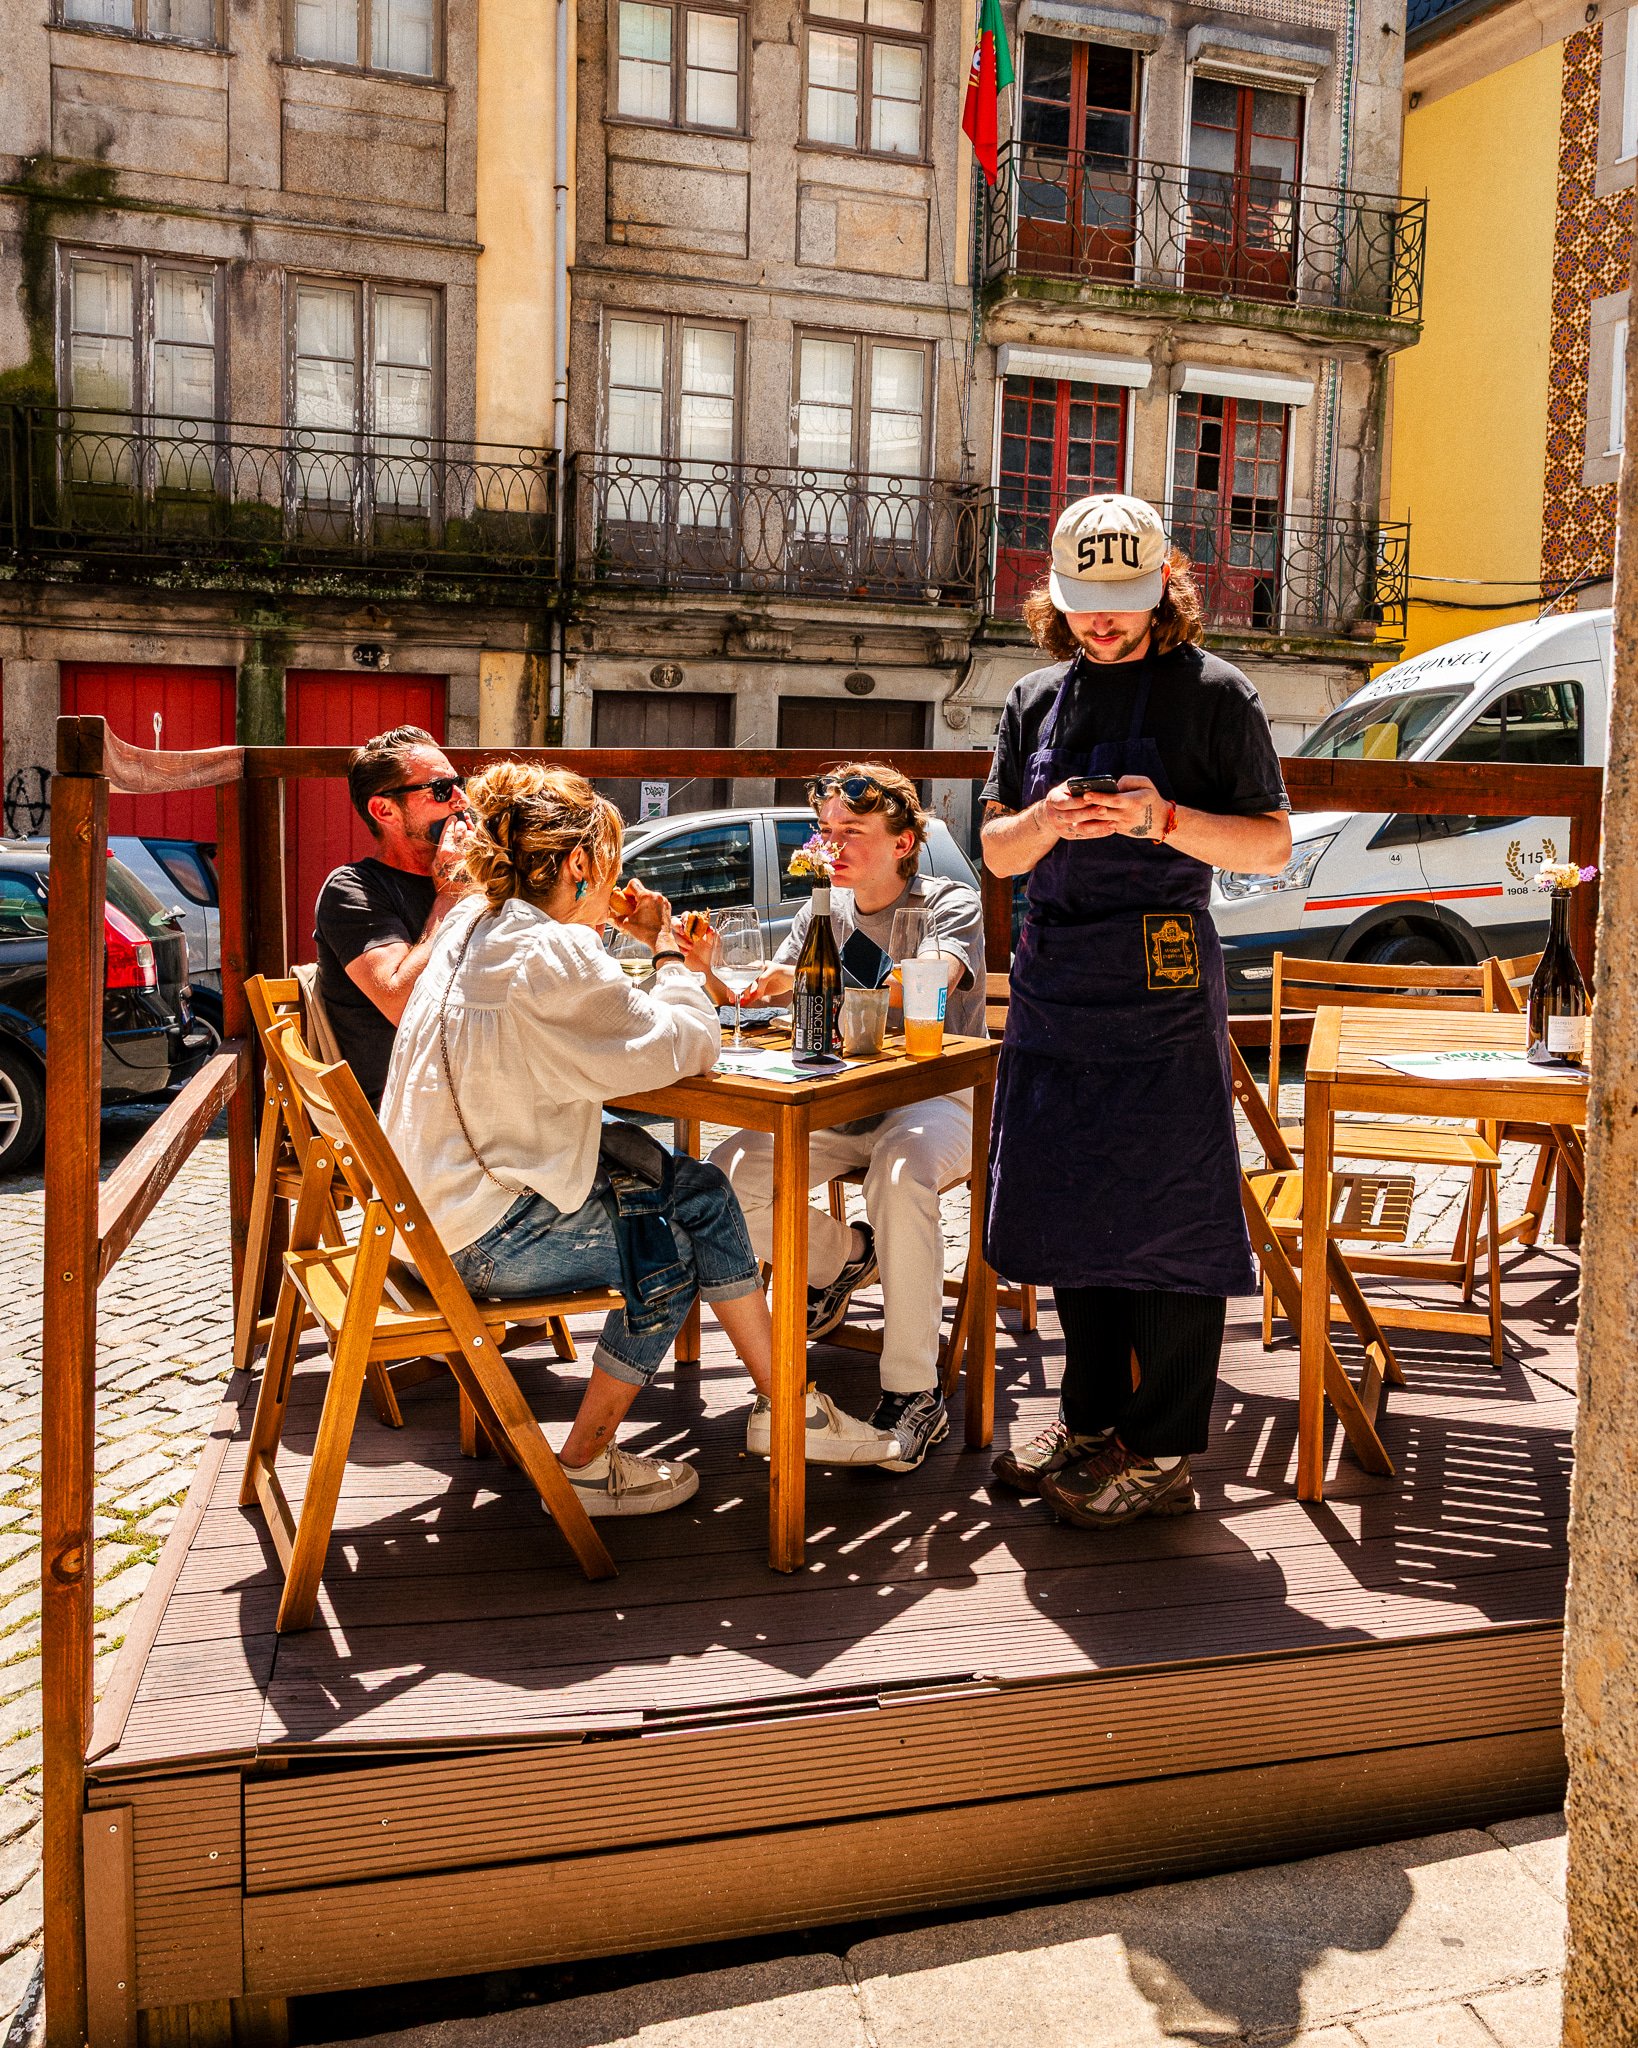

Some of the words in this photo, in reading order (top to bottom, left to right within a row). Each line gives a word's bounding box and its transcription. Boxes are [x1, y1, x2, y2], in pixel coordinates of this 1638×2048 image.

[1077, 532, 1140, 573] STU
[354, 650, 381, 662] 24
[1390, 854, 1401, 862] 44
[1519, 851, 1544, 865] 115
[1507, 886, 1529, 896] 1908
[1537, 884, 1556, 893] 202
[813, 995, 824, 1051] CONCEITO
